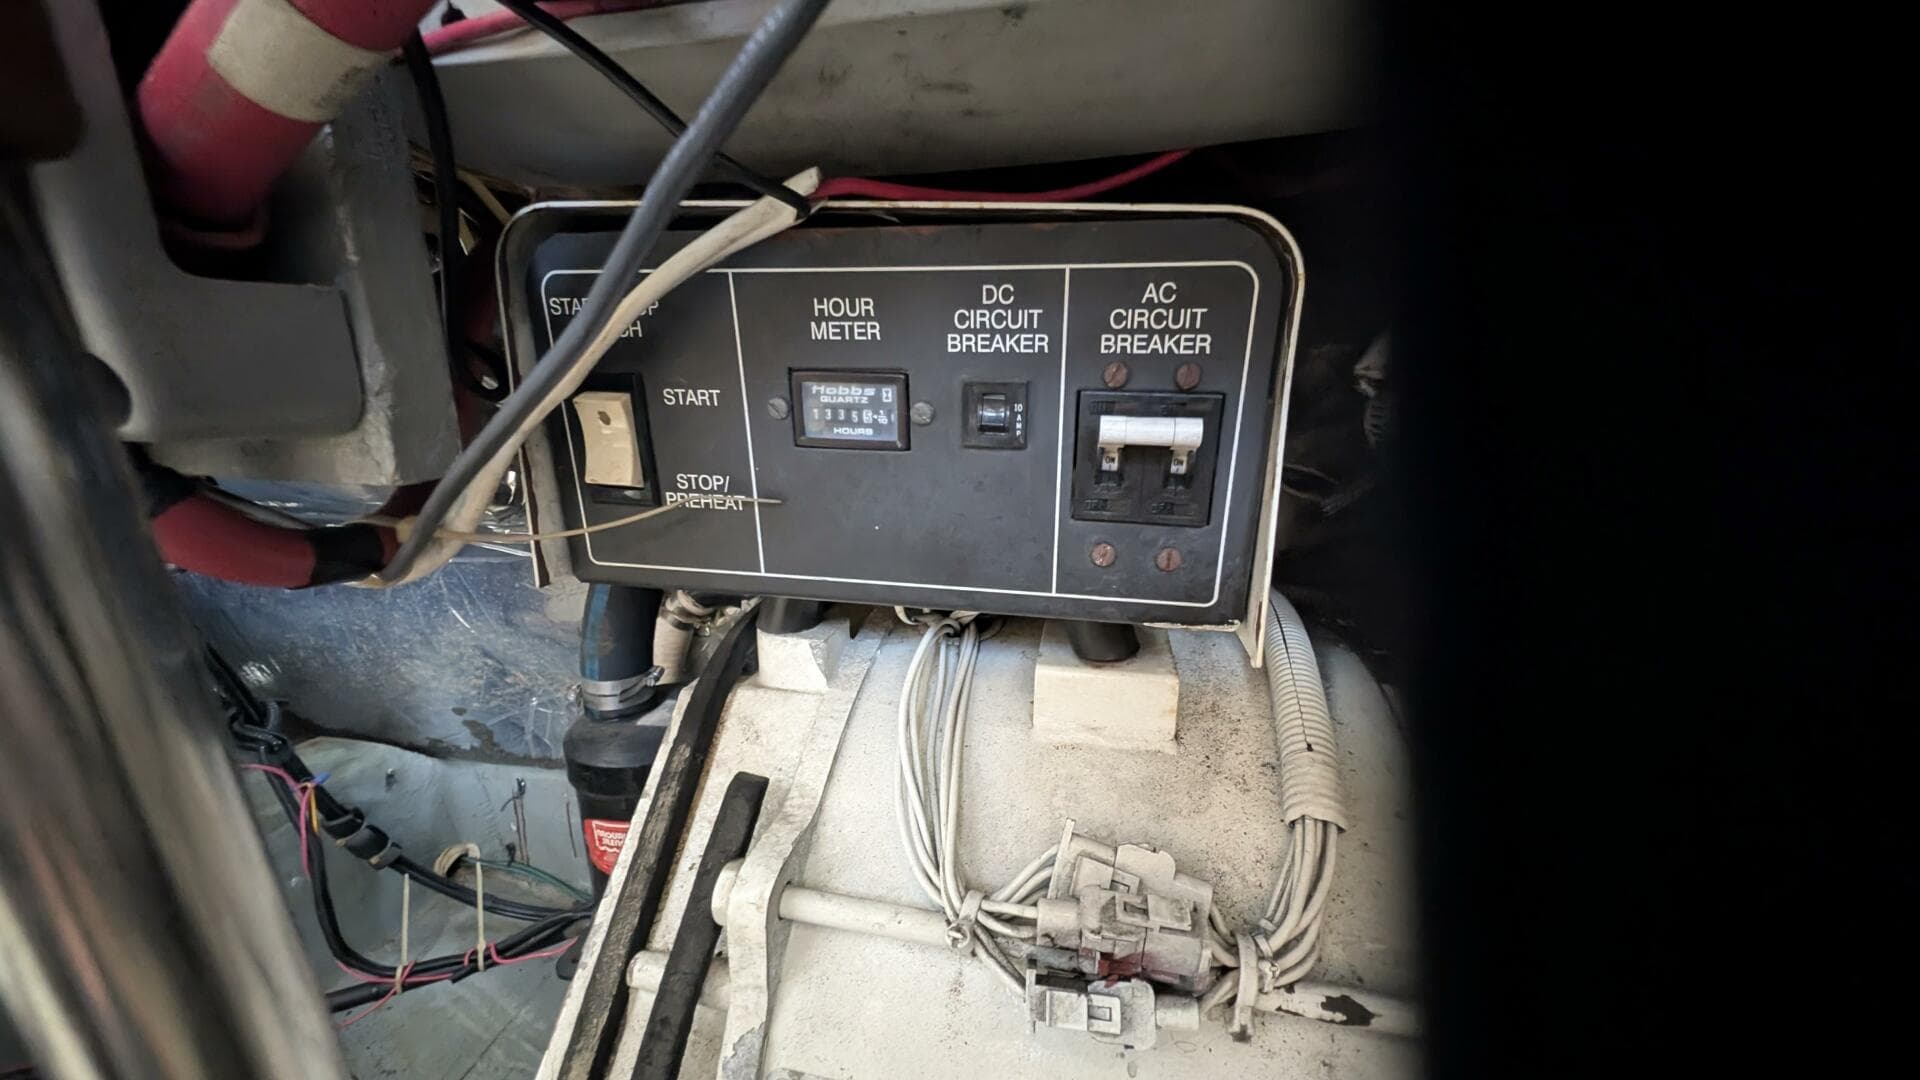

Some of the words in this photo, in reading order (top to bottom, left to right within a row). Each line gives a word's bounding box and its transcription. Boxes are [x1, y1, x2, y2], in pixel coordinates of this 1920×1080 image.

[982, 284, 1015, 305] DC
[1141, 281, 1178, 304] AC
[813, 297, 875, 318] HOUR
[953, 309, 1043, 330] CIRCUIT
[1109, 308, 1208, 330] CIRCUIT
[810, 321, 881, 341] METER
[946, 333, 1049, 353] BREAKER
[1100, 333, 1212, 355] BREAKER
[662, 388, 721, 407] START
[811, 385, 876, 396] Hobbs
[820, 395, 869, 404] QUARTZ
[833, 427, 874, 436] HOURS
[1105, 455, 1116, 464] ON
[676, 473, 730, 493] STOP/
